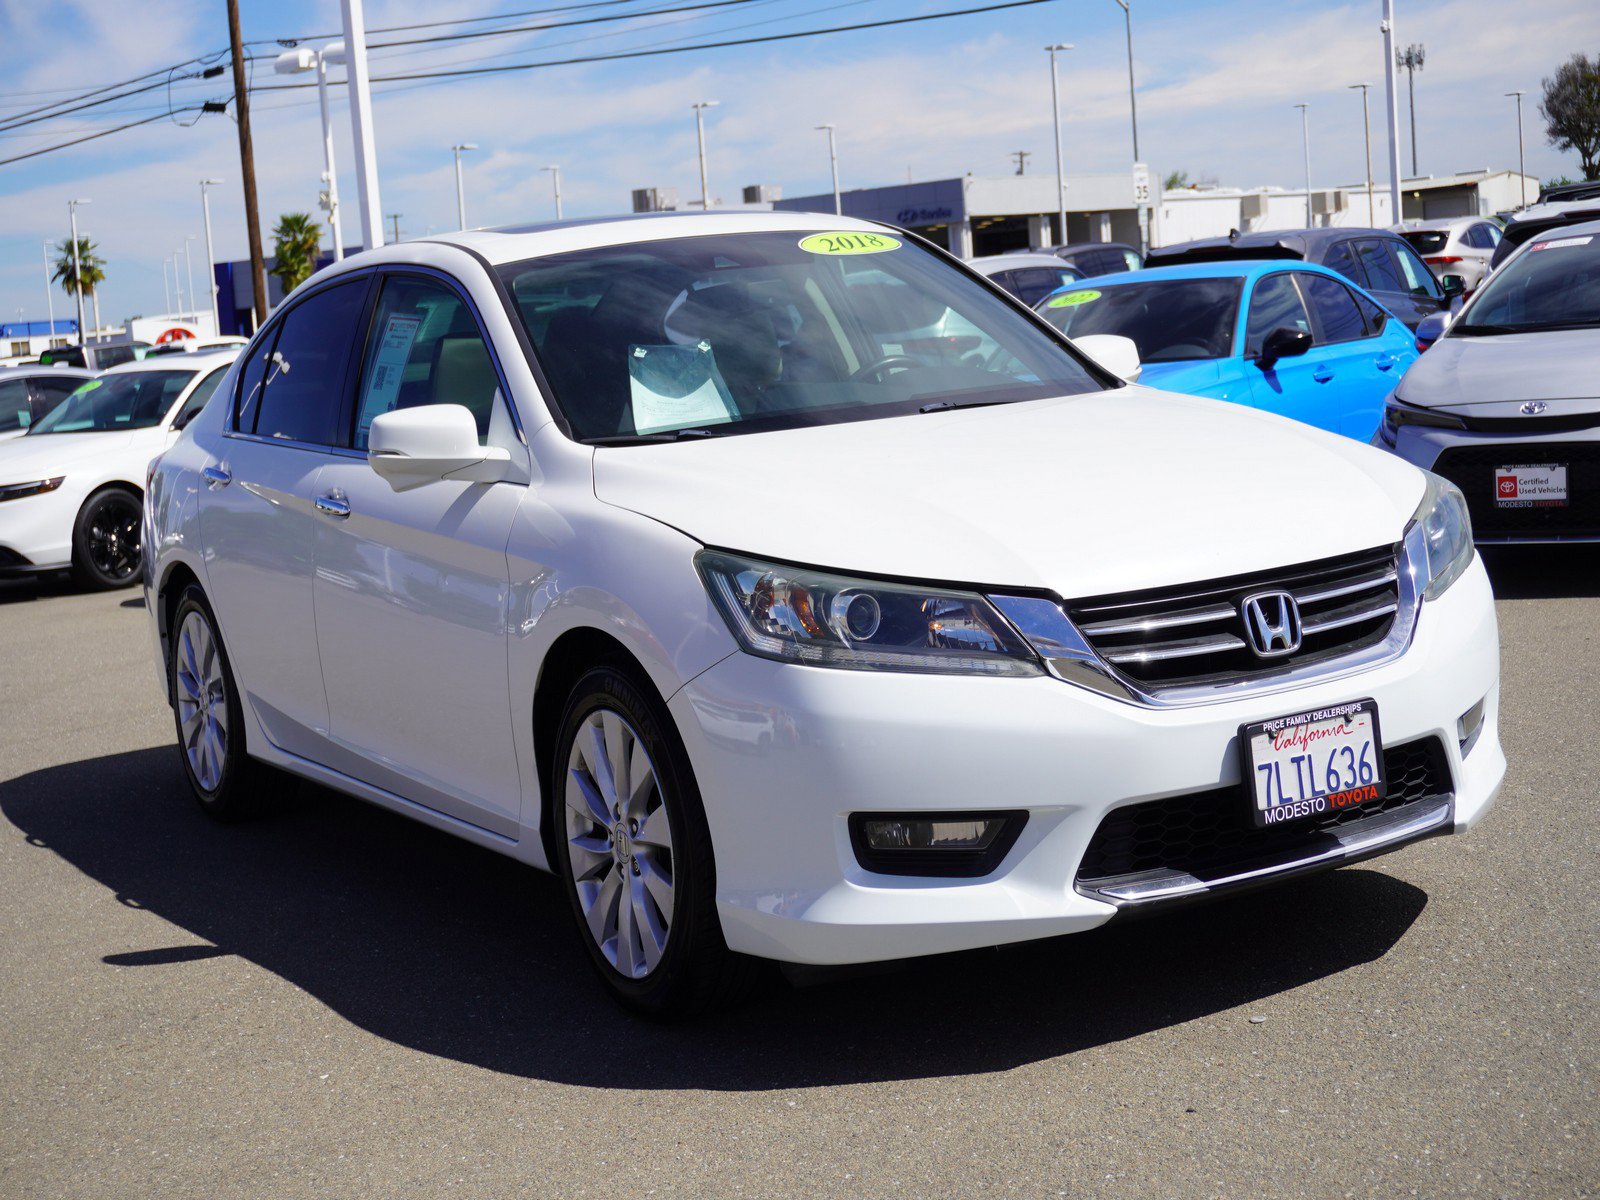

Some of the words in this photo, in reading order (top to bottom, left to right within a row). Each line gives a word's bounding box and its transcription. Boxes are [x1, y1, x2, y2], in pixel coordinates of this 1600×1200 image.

[1136, 185, 1149, 200] 35
[819, 234, 884, 252] 2018
[1518, 486, 1537, 494] Used
[1538, 486, 1567, 494] Vehicles
[1498, 500, 1533, 508] MODESTO
[1535, 499, 1563, 507] TOYOTA
[1263, 720, 1285, 732] PRICE
[1286, 713, 1313, 727] FAMILY
[1313, 703, 1362, 721] DEALERSHIPS
[1274, 722, 1354, 752] California
[1257, 740, 1373, 808] 7LTL636
[1264, 797, 1326, 825] MODESTO
[1328, 785, 1379, 809] TOYOTA
